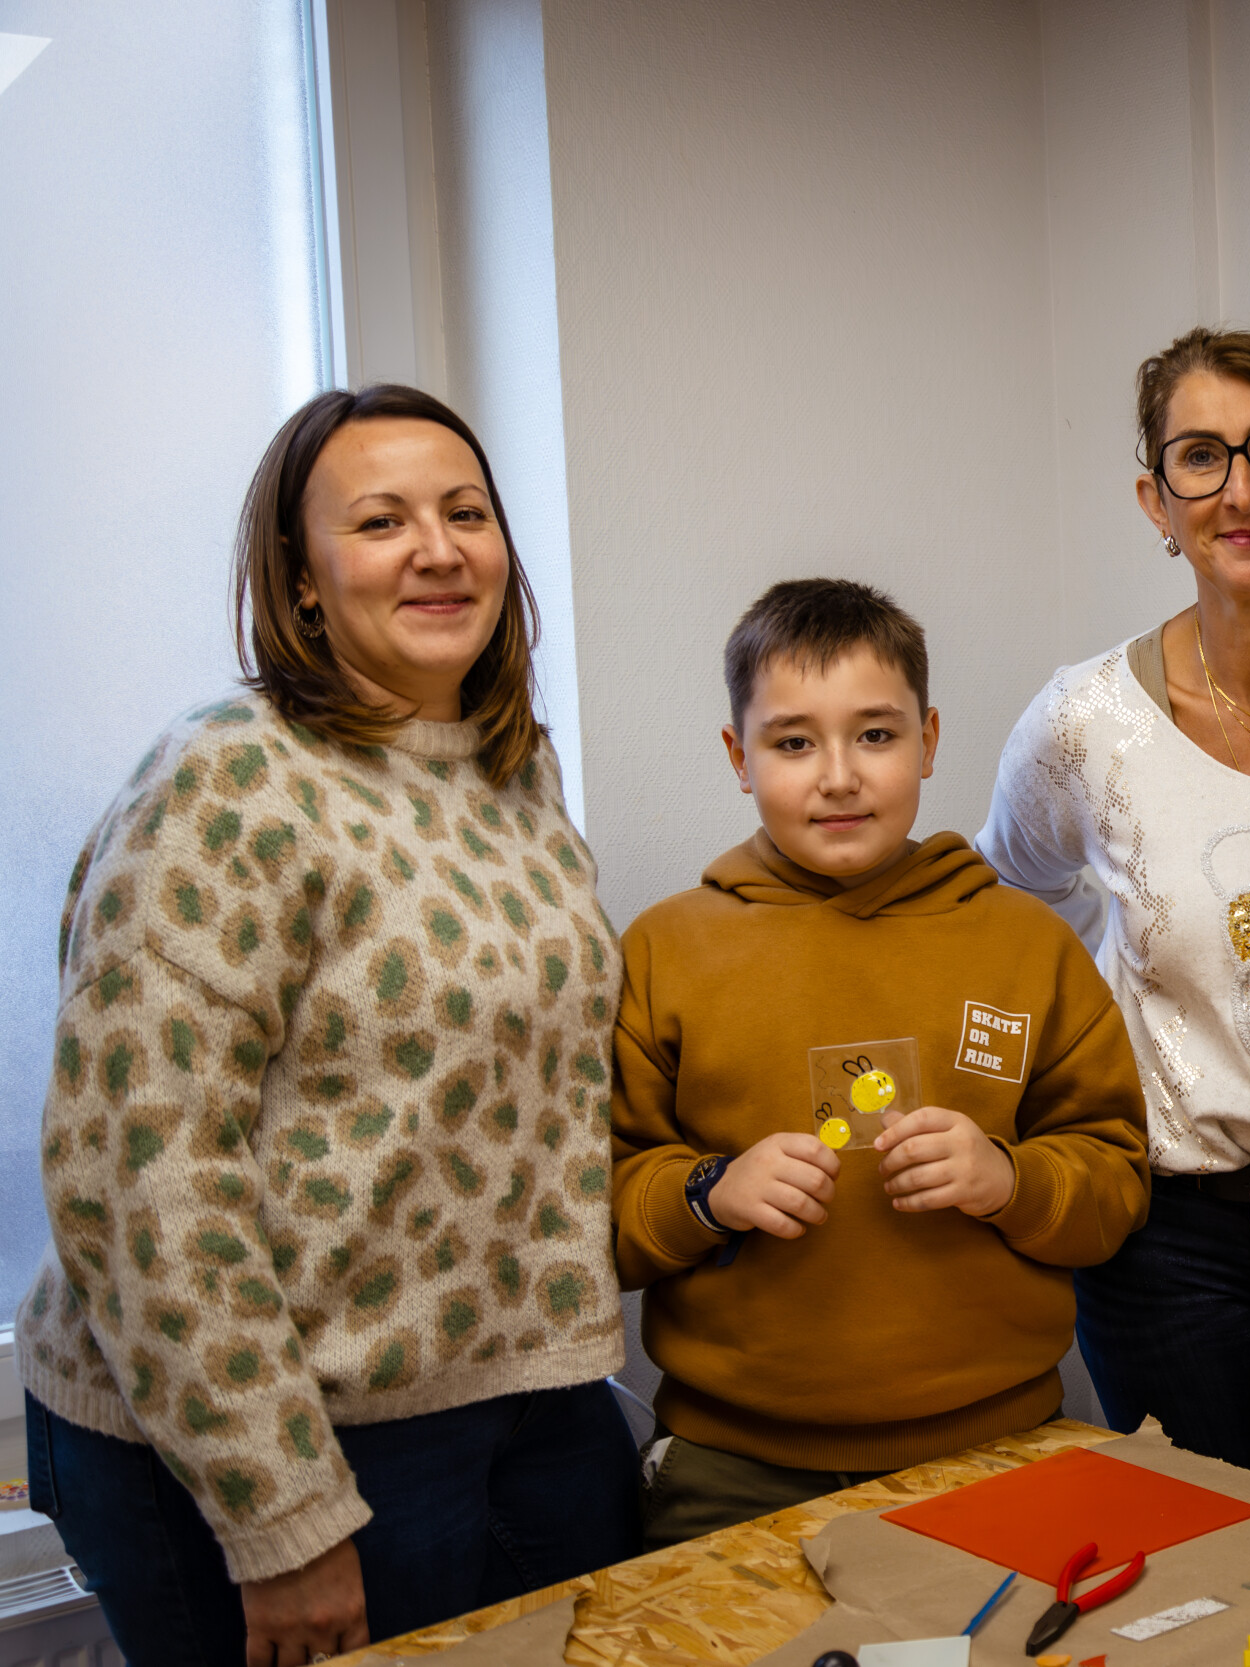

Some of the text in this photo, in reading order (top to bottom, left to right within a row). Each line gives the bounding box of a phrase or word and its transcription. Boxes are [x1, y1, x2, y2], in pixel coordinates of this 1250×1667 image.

[971, 1009, 1022, 1034] SKATE
[969, 1028, 990, 1047] OR
[964, 1048, 1003, 1071] RIDE
